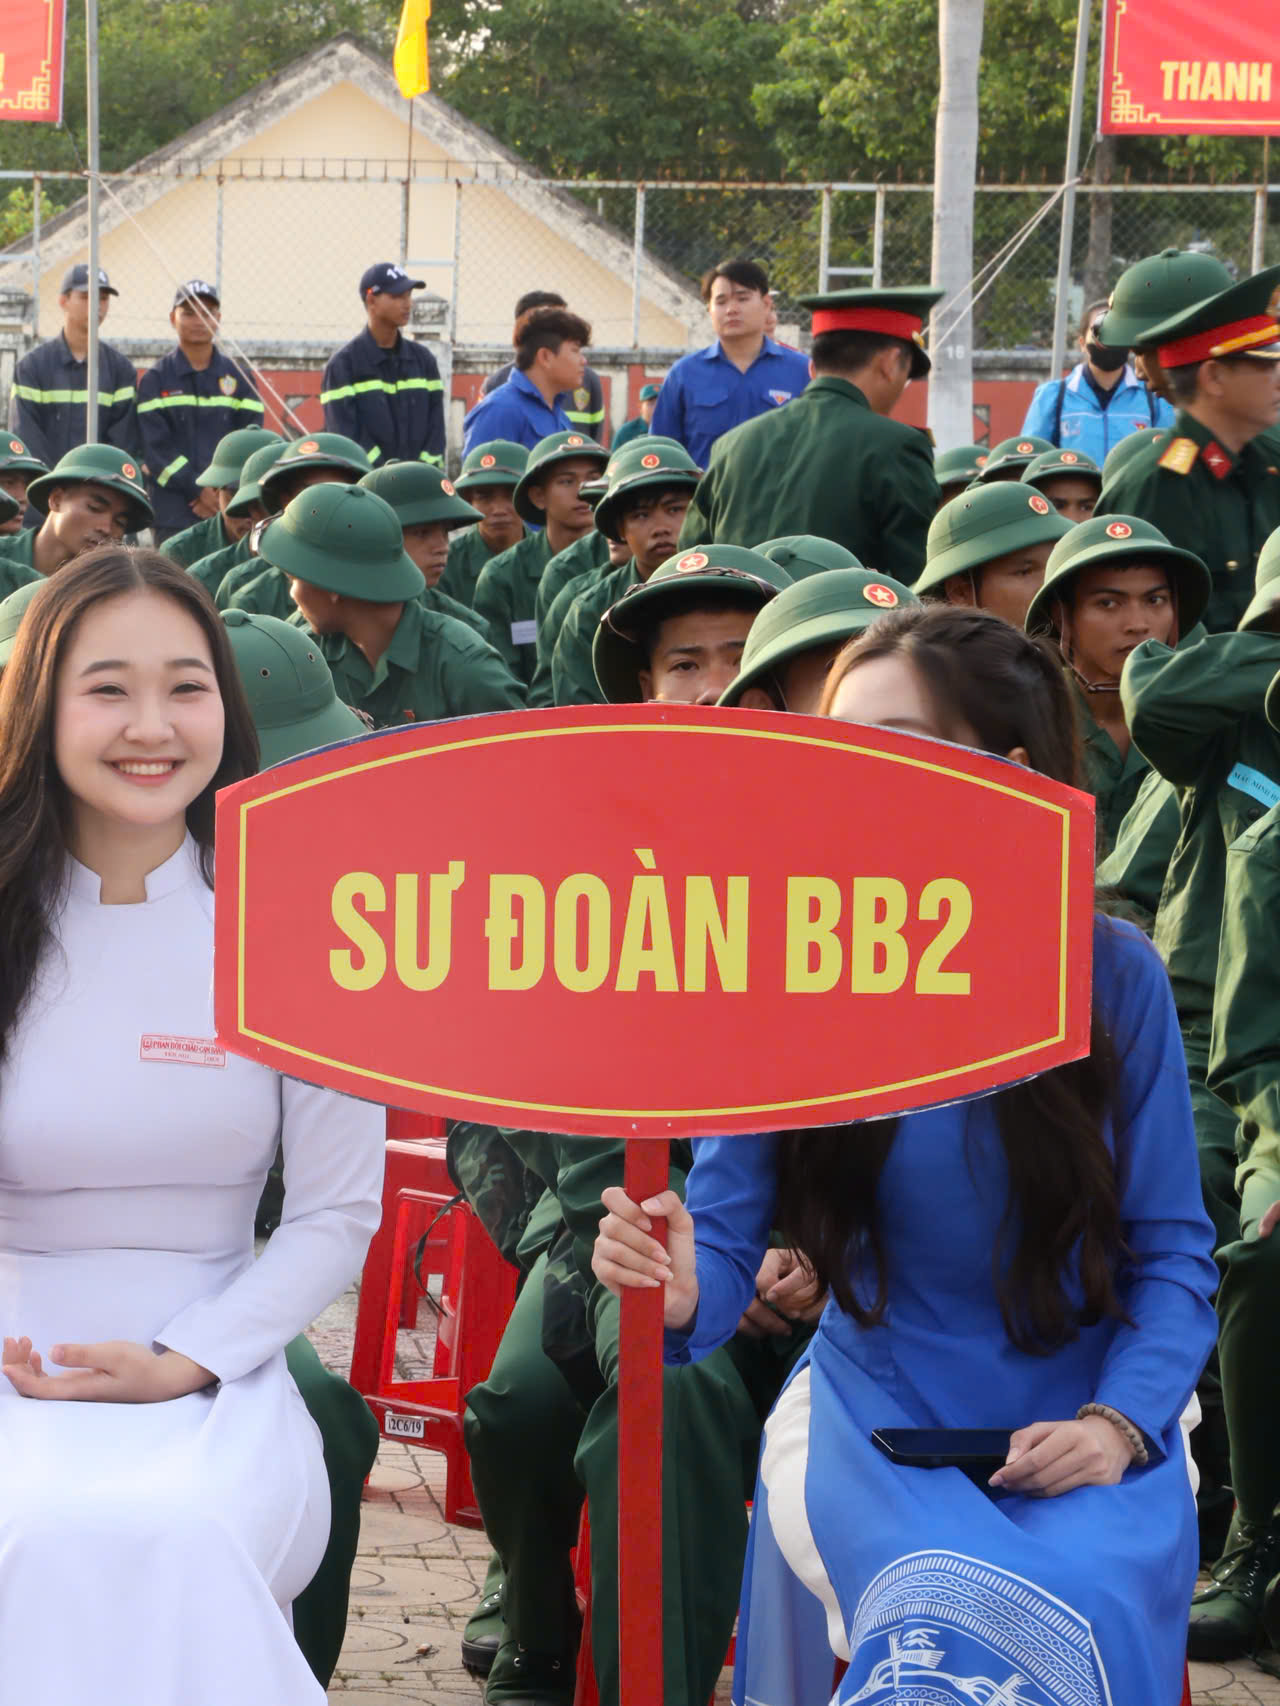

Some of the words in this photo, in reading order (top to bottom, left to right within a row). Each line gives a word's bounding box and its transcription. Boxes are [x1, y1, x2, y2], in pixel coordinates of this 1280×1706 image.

[1160, 61, 1272, 102] THANH
[329, 861, 465, 992] SƯ
[484, 848, 749, 993] ĐOÀN
[785, 876, 973, 995] BB2
